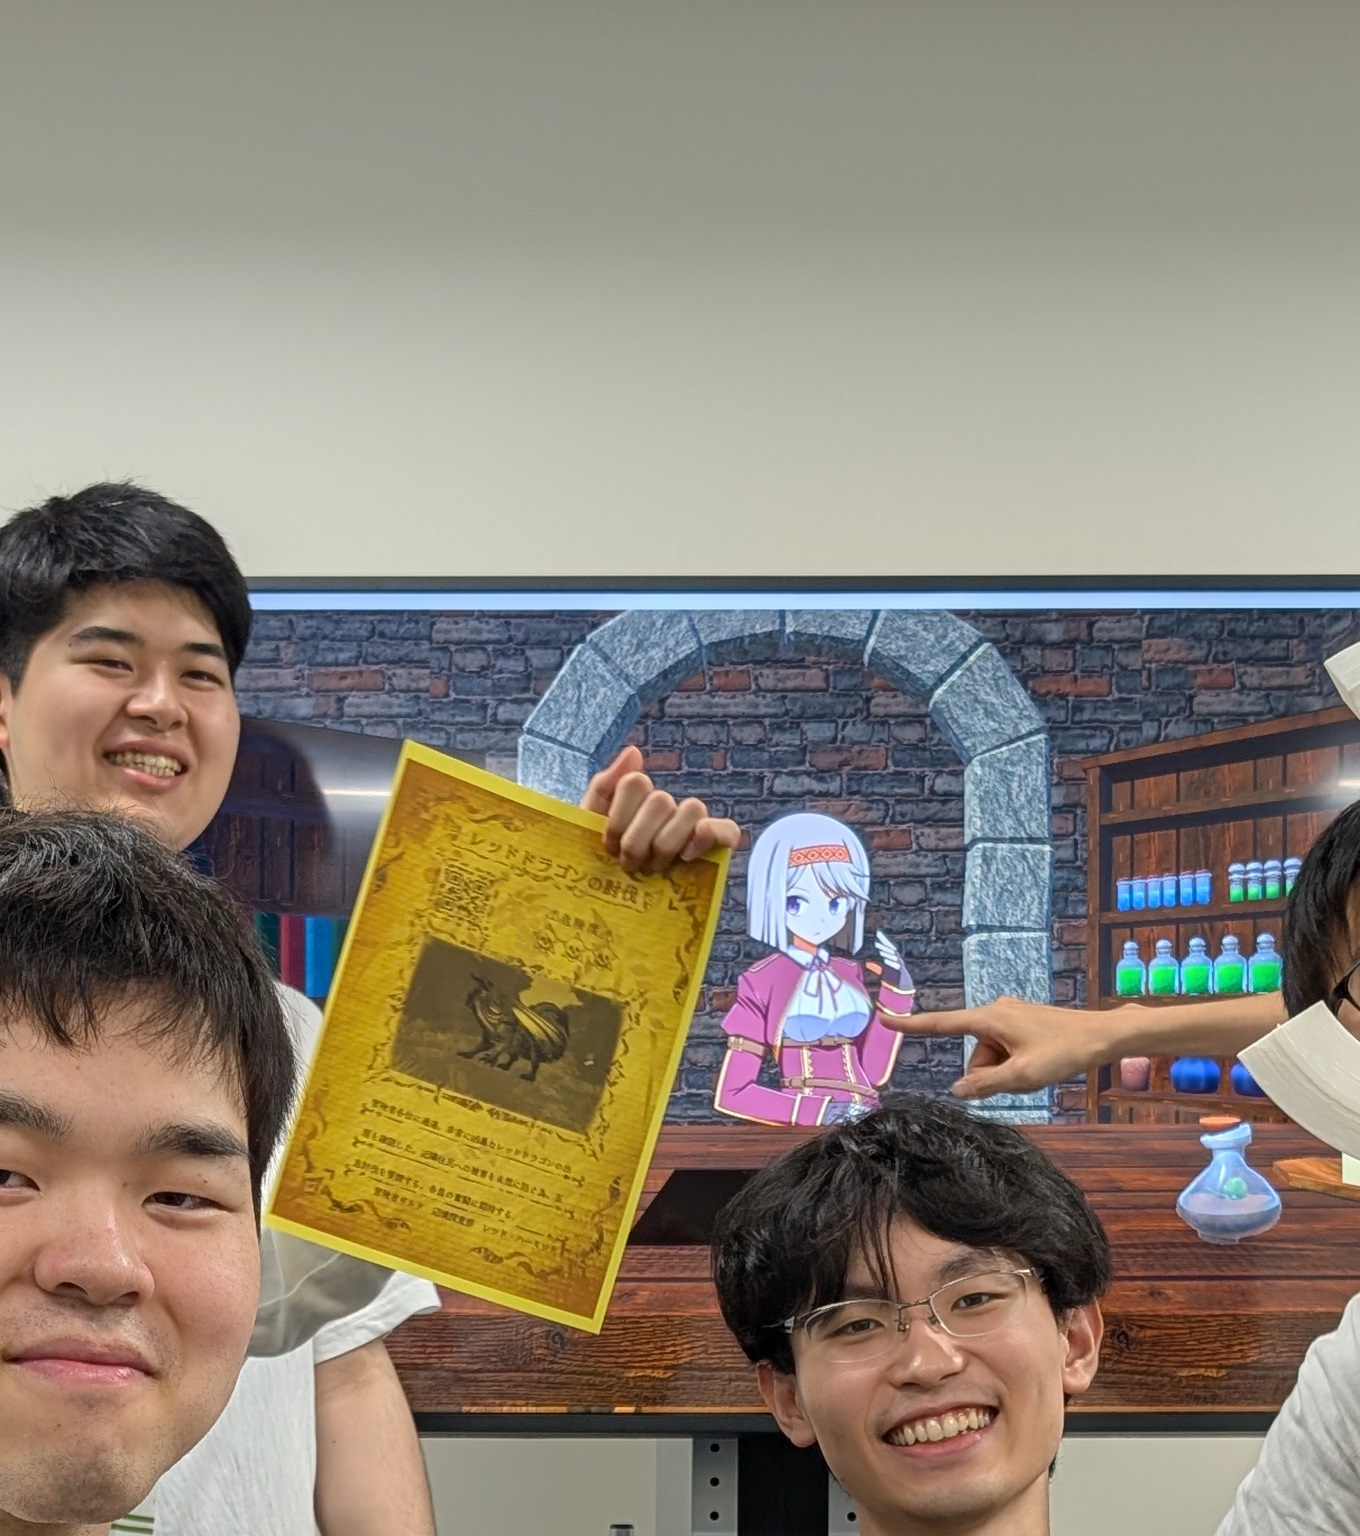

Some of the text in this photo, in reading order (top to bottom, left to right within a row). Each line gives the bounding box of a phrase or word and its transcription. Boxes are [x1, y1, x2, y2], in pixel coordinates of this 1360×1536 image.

[467, 831, 641, 906] レッドドラゴンの討伐
